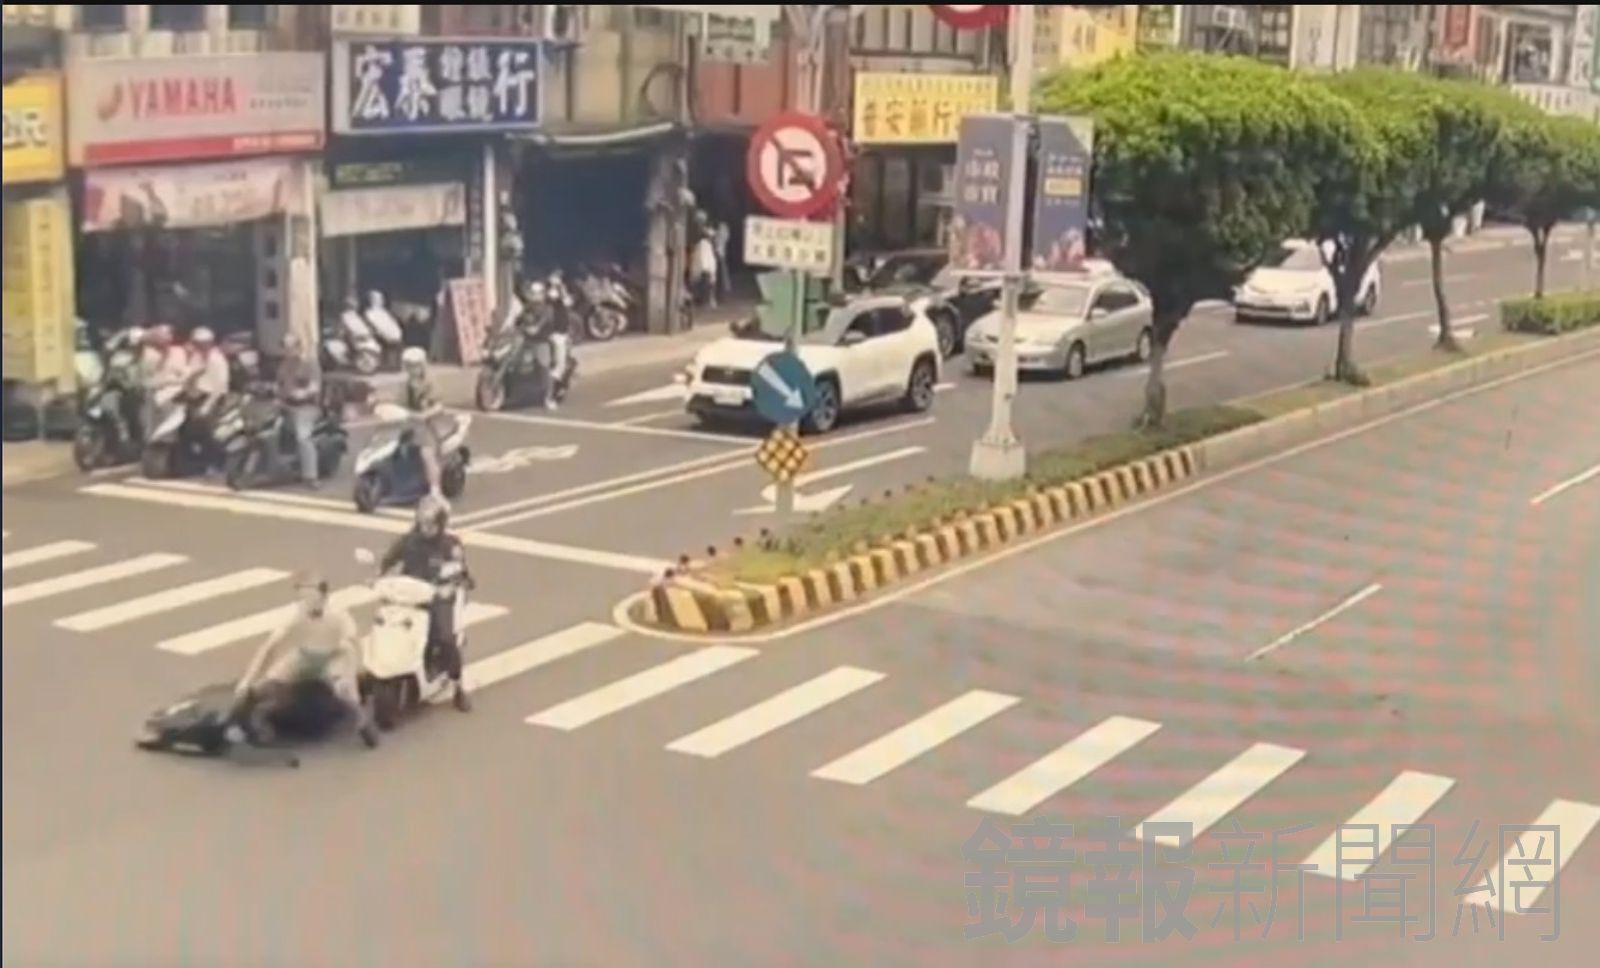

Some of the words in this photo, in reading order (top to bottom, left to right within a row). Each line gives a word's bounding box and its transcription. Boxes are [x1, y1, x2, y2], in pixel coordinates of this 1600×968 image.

[128, 77, 237, 119] YAMAHA
[352, 44, 437, 121] 宏泰
[494, 51, 536, 117] 行
